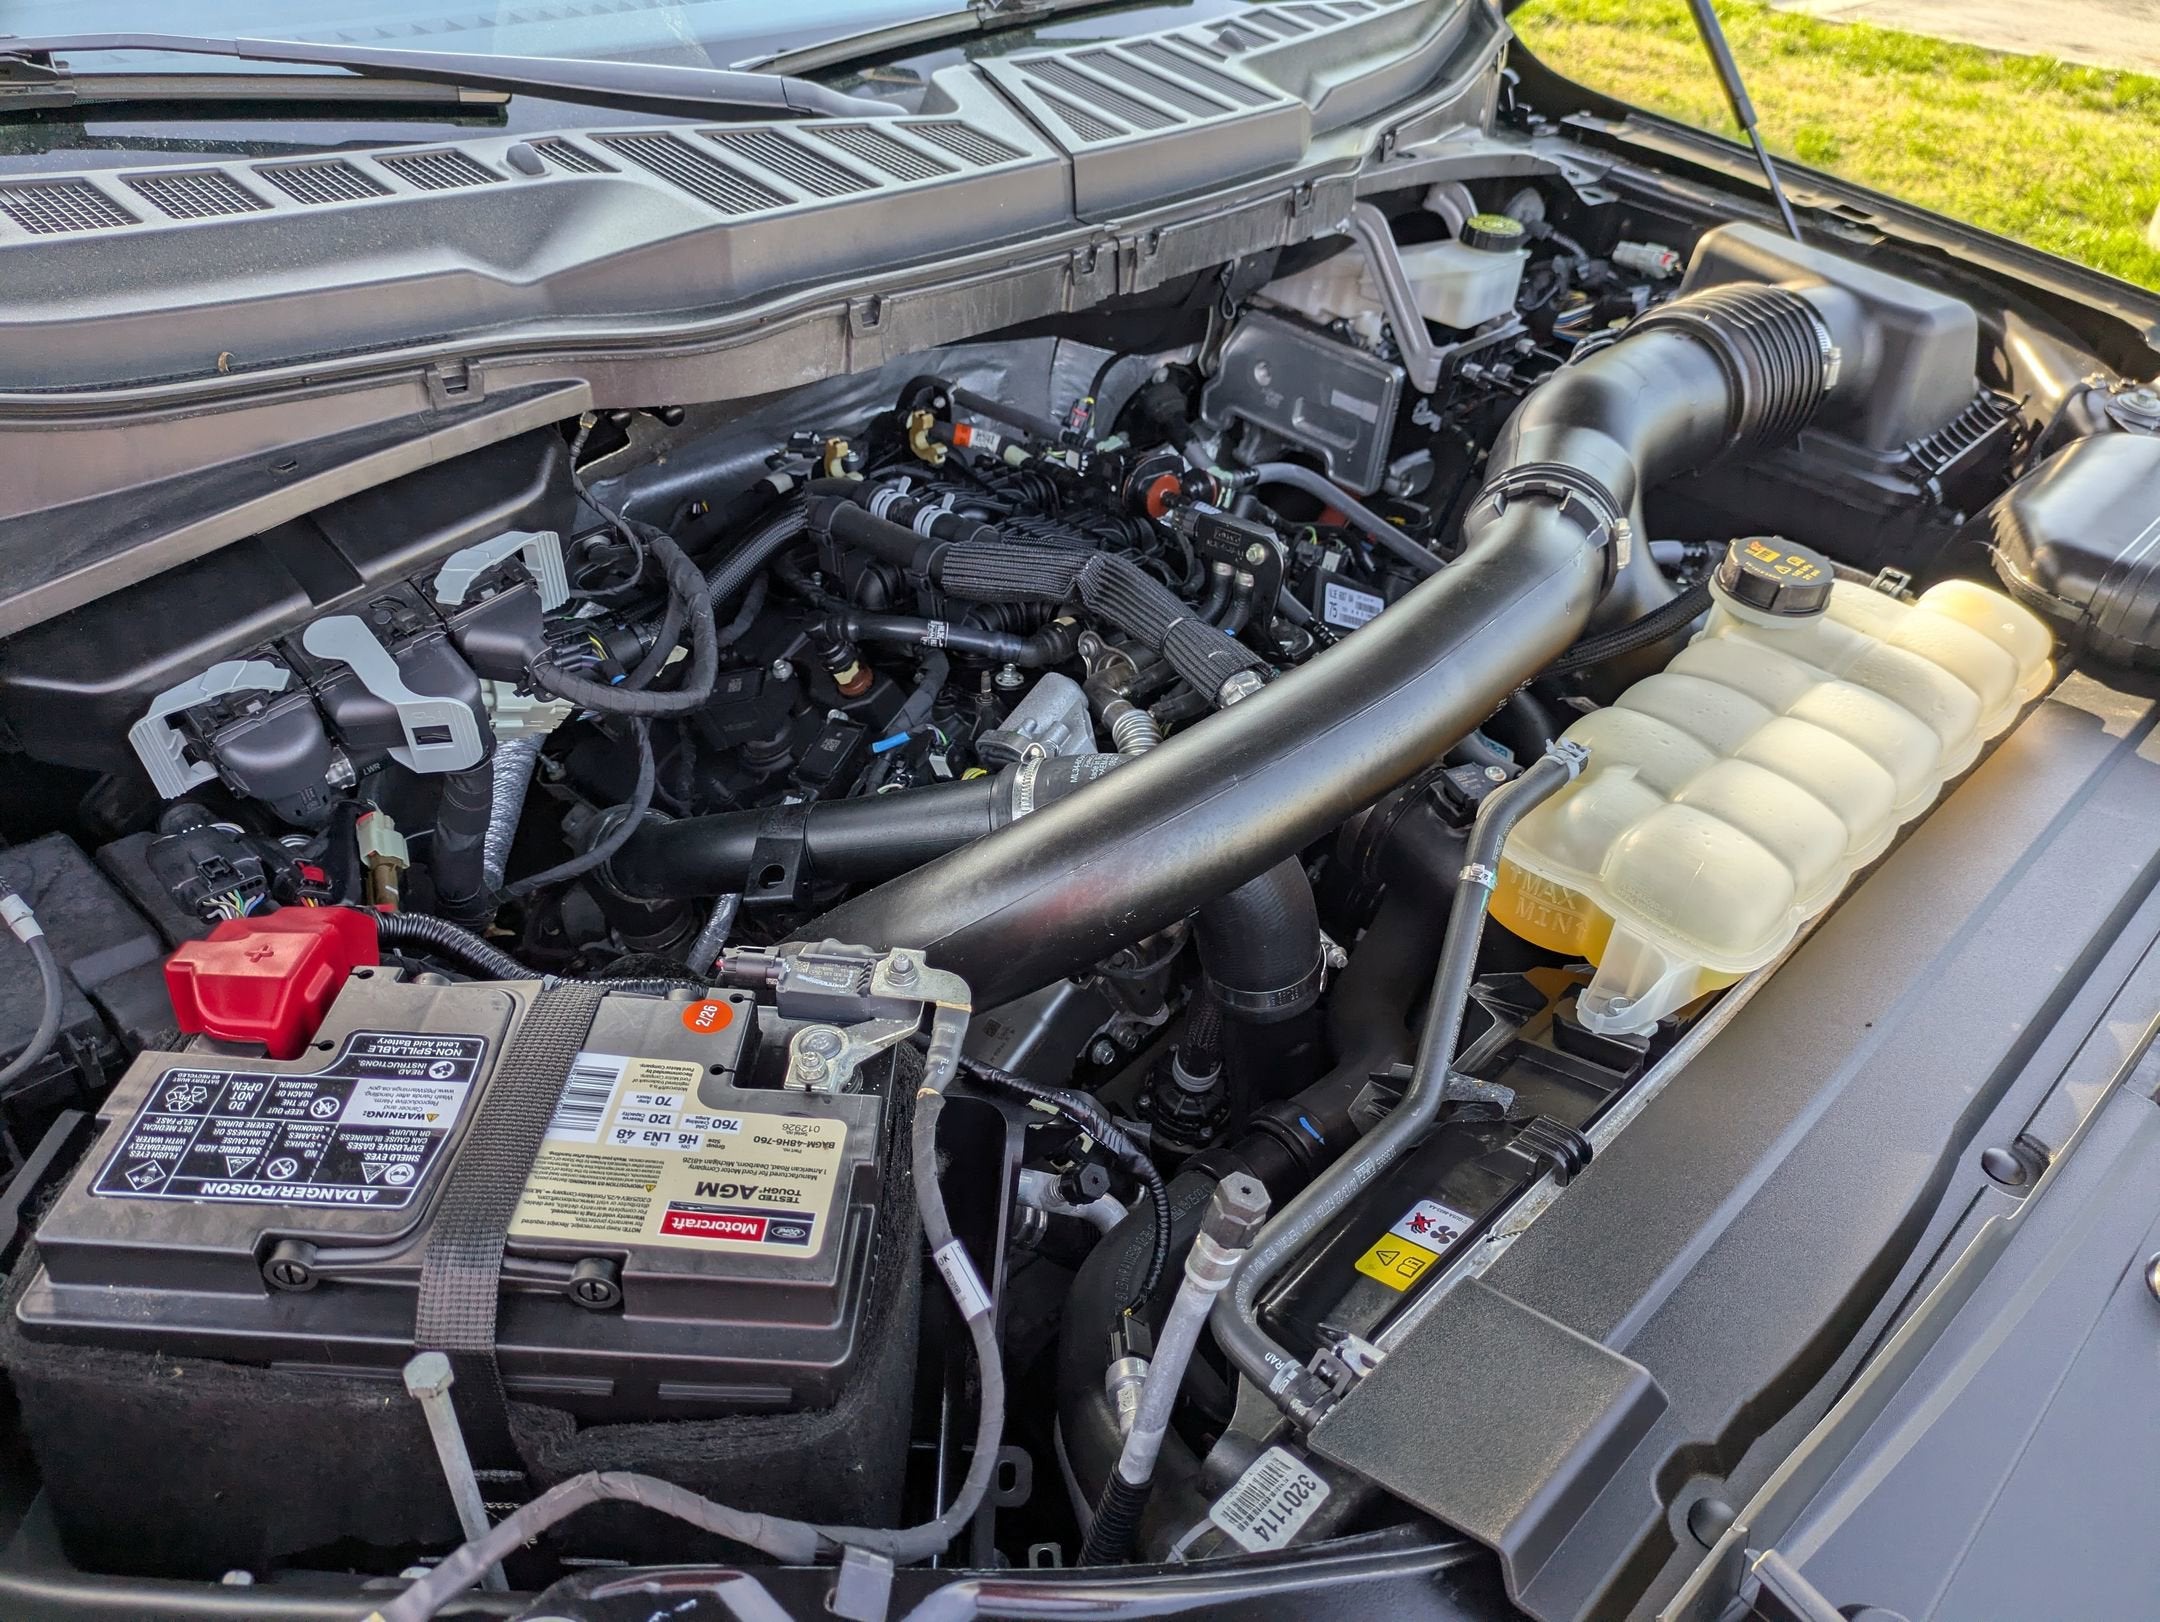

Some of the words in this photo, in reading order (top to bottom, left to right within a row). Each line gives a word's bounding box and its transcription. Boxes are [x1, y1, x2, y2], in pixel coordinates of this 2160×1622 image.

[1522, 873, 1577, 911] MAX
[1515, 897, 1574, 935] MIN
[695, 1005, 718, 1027] 2/26
[377, 1038, 412, 1046] Battery
[367, 1045, 462, 1056] NON-SPILLABLE
[358, 1060, 427, 1069] INSTRUCTIONS.
[231, 1082, 263, 1091] OPEN.
[278, 1081, 318, 1090] CHILDREN.
[232, 1091, 255, 1100] NOT
[288, 1090, 314, 1098] REACH
[228, 1101, 245, 1110] DO
[655, 1096, 672, 1106] 70
[267, 1106, 283, 1114] OUT
[363, 1110, 425, 1120] WARNING:
[649, 1114, 671, 1124] 120
[143, 1123, 177, 1131] MEDICAL
[215, 1120, 244, 1128] BURNS.
[245, 1121, 275, 1129] SEVERE
[287, 1123, 325, 1132] SMOKING
[712, 1119, 738, 1130] 760
[782, 1123, 821, 1133] 012926
[225, 1128, 270, 1136] BLINDNESS
[288, 1132, 321, 1140] FLAMES
[616, 1129, 636, 1139] 48
[643, 1131, 671, 1142] LN3
[135, 1135, 162, 1143] WATER.
[221, 1137, 249, 1145] CAUSE
[339, 1134, 383, 1142] BLINDNESS
[384, 1135, 410, 1143] CAUSE
[678, 1134, 698, 1144] H6
[753, 1135, 835, 1149] BAGM-48H6-760
[128, 1143, 182, 1151] IMMEDIATELY
[195, 1144, 218, 1152] ACID
[284, 1140, 317, 1148] SPARKS
[347, 1142, 375, 1150] GASES
[377, 1143, 425, 1152] EXPLOSIVE
[129, 1150, 150, 1158] EYES
[219, 1145, 262, 1155] SULFURIC
[151, 1151, 179, 1159] FLUSH
[389, 1153, 420, 1161] SHIELD
[704, 1158, 734, 1167] Michigan
[735, 1161, 769, 1169] Dearborn,
[790, 1166, 823, 1174] American
[769, 1171, 818, 1180] Manufactured
[201, 1183, 360, 1200] DANGER/POISON
[695, 1181, 759, 1200] AGM
[758, 1195, 800, 1204] TESTED
[579, 1204, 607, 1212] warranty
[607, 1218, 634, 1226] warranty
[671, 1217, 758, 1235] Motorcraft
[938, 1253, 950, 1266] OK
[1265, 1352, 1285, 1370] RAD
[1252, 1474, 1317, 1542] 3201114
